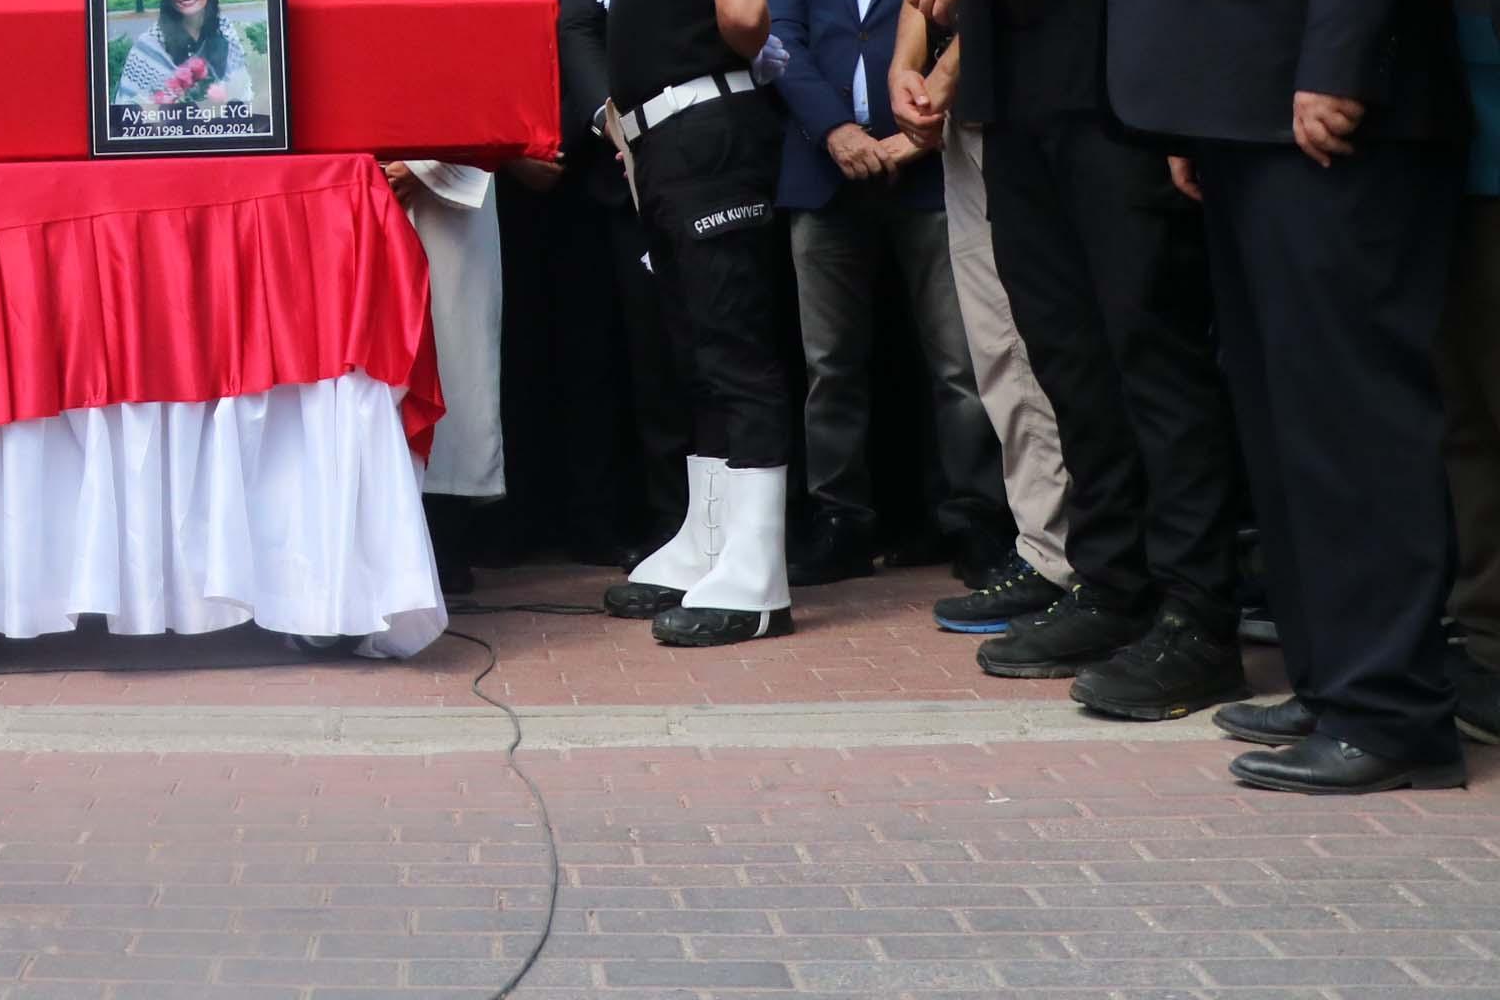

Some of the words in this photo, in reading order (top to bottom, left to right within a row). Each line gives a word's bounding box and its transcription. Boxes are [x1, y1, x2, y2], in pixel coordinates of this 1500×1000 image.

[121, 107, 182, 124] Ayşenur
[186, 105, 216, 122] Ezgi
[220, 102, 254, 119] EYGİ
[122, 125, 184, 137] 27.07.1998
[192, 123, 254, 136] 06.09.2024
[726, 204, 764, 222] KUVVET
